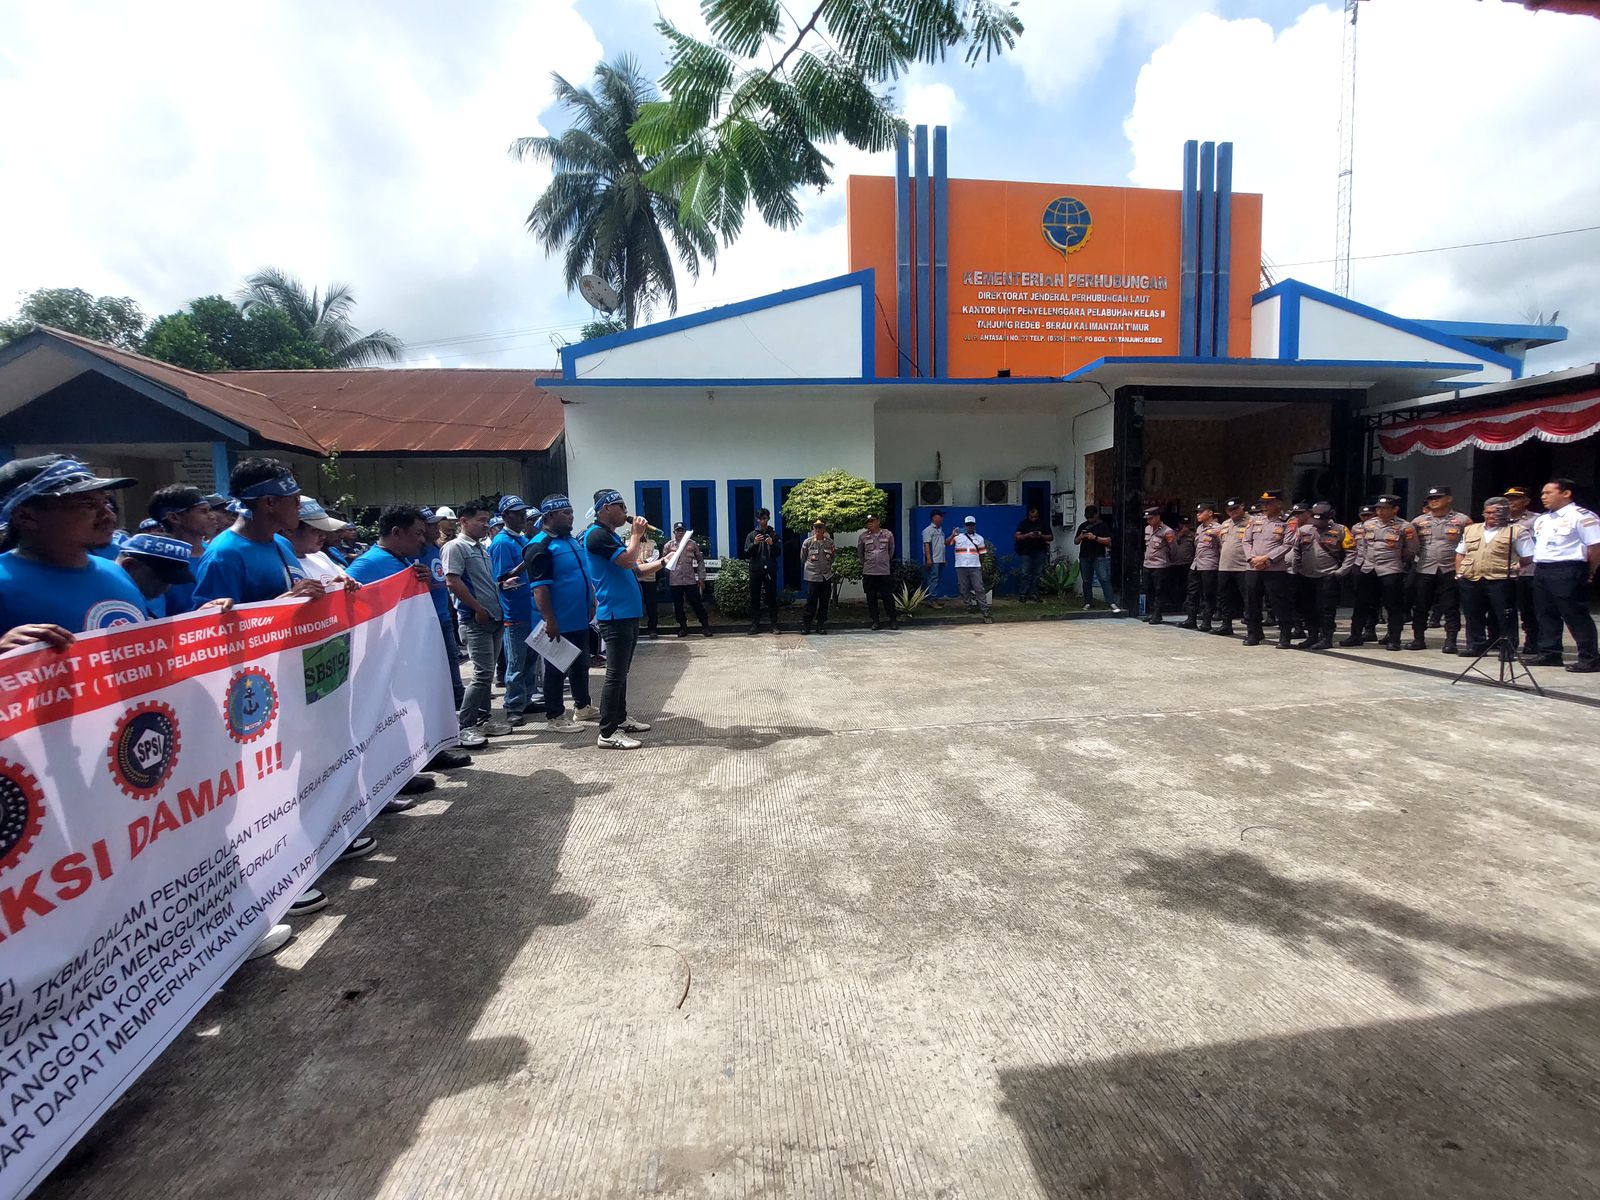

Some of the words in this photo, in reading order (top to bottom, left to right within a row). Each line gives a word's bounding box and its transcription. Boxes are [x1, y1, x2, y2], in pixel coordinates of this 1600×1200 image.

[962, 305, 996, 315] KANTOR
[997, 306, 1016, 315] UNIT
[1017, 306, 1085, 316] PENYELENGGARA
[1087, 307, 1132, 317] PELABUHAN
[1134, 309, 1160, 318] KELAS
[963, 271, 1064, 288] KEMENTERIAN
[1068, 273, 1168, 290] PERHUBUNGAN
[977, 320, 1013, 330] TANJUNG
[1014, 321, 1041, 330] REDEB
[1045, 321, 1072, 331] BERAU
[1073, 322, 1124, 332] KALIMANTAN
[1125, 323, 1150, 332] TIMUR
[978, 291, 1028, 301] DIREKTORAT
[1030, 292, 1069, 302] JENDERAL
[1072, 293, 1128, 303] PERHUBUNGAN
[1130, 295, 1150, 304] LAUT
[27, 682, 86, 713] MUAT
[104, 663, 152, 688] TKBM
[167, 640, 245, 671] PELABUHAN
[249, 629, 291, 649] SELURUH
[295, 615, 338, 636] INDONESIA
[89, 638, 168, 668] PEKERJA
[178, 622, 234, 646] SERIKAT
[239, 615, 275, 632] BURUH
[137, 735, 162, 763] SPSI
[0, 838, 113, 943] KSI
[128, 759, 245, 861] DAMAI
[255, 741, 283, 780] !!!
[32, 950, 88, 1005] TKBM
[93, 900, 146, 958] DALAM
[150, 826, 252, 909] PENGELOLAAN
[254, 797, 298, 834] TENAGA
[298, 776, 321, 802] KERJA
[322, 749, 357, 783] BONGKAR
[375, 706, 408, 736] PELABUHAN
[0, 992, 65, 1053] UASI
[71, 917, 158, 1001] KEGIATAN
[162, 855, 241, 923] CONTAINER
[0, 1124, 36, 1172] AR
[34, 1049, 104, 1127] DAPAT
[105, 926, 238, 1055] MEMPERHATIKAN
[235, 874, 294, 931] KENAIKAN
[291, 848, 318, 878] TARIF
[342, 793, 371, 827] BERKALA
[371, 771, 393, 797] SESUAI
[60, 975, 117, 1028] YANG
[120, 876, 237, 981] MENGGUNAKAN
[239, 834, 288, 884] FORKLIFT
[11, 1012, 116, 1117] ANGGOTA
[113, 935, 196, 1014] KOPERASI
[196, 902, 235, 940] TKBM
